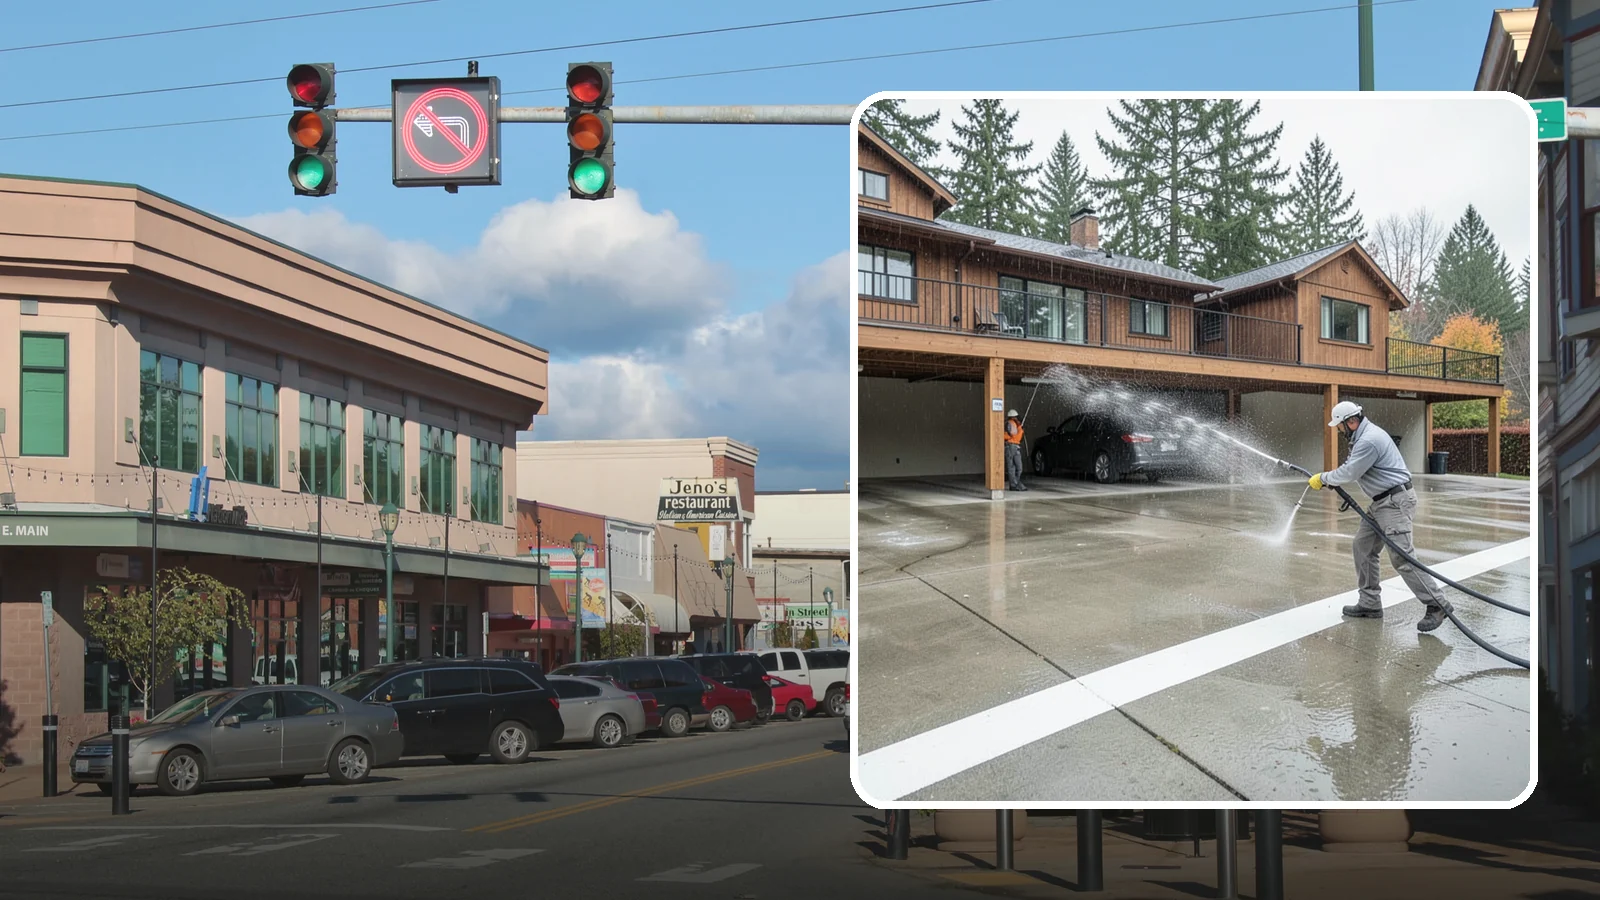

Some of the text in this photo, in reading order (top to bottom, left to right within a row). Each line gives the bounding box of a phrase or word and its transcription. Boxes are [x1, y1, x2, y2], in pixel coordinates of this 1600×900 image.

[670, 480, 728, 494] Jeno's
[665, 496, 731, 508] restaurant
[658, 510, 681, 519] Italian
[686, 510, 714, 519] American
[715, 510, 737, 519] Cuisine
[2, 525, 48, 536] E. MAIN
[798, 608, 828, 616] Street
